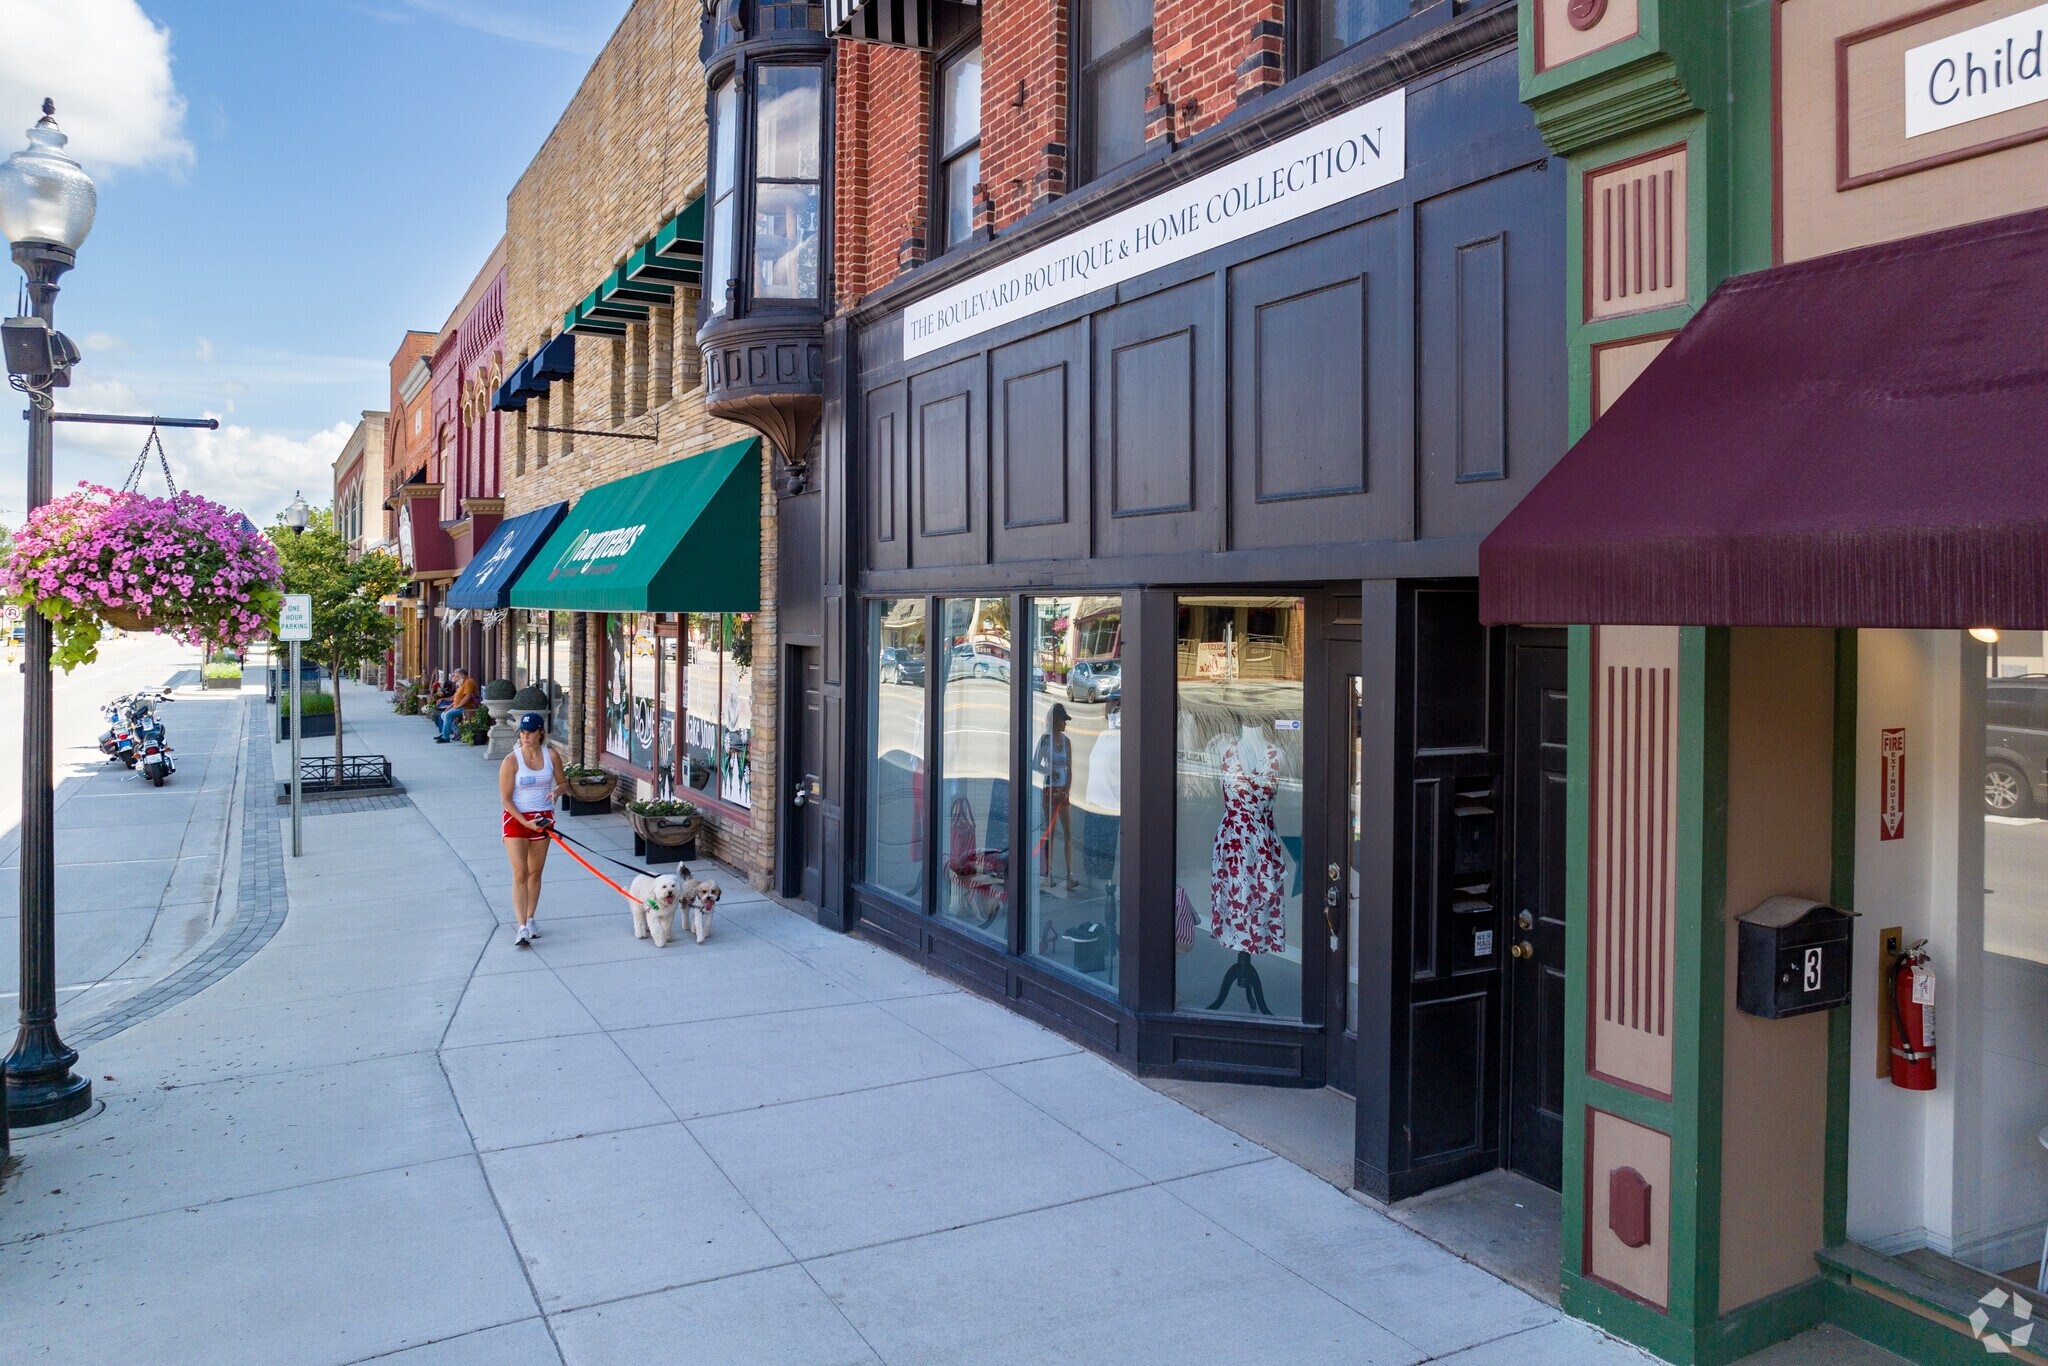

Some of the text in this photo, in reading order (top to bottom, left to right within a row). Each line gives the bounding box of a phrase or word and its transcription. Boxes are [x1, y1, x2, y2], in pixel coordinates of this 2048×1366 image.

[1928, 30, 2043, 106] Child
[910, 126, 1383, 341] THE BOULEVARD BOUTIQUE & HOME COLLECTION
[1884, 736, 1903, 752] FIRE
[1806, 949, 1819, 989] 3
